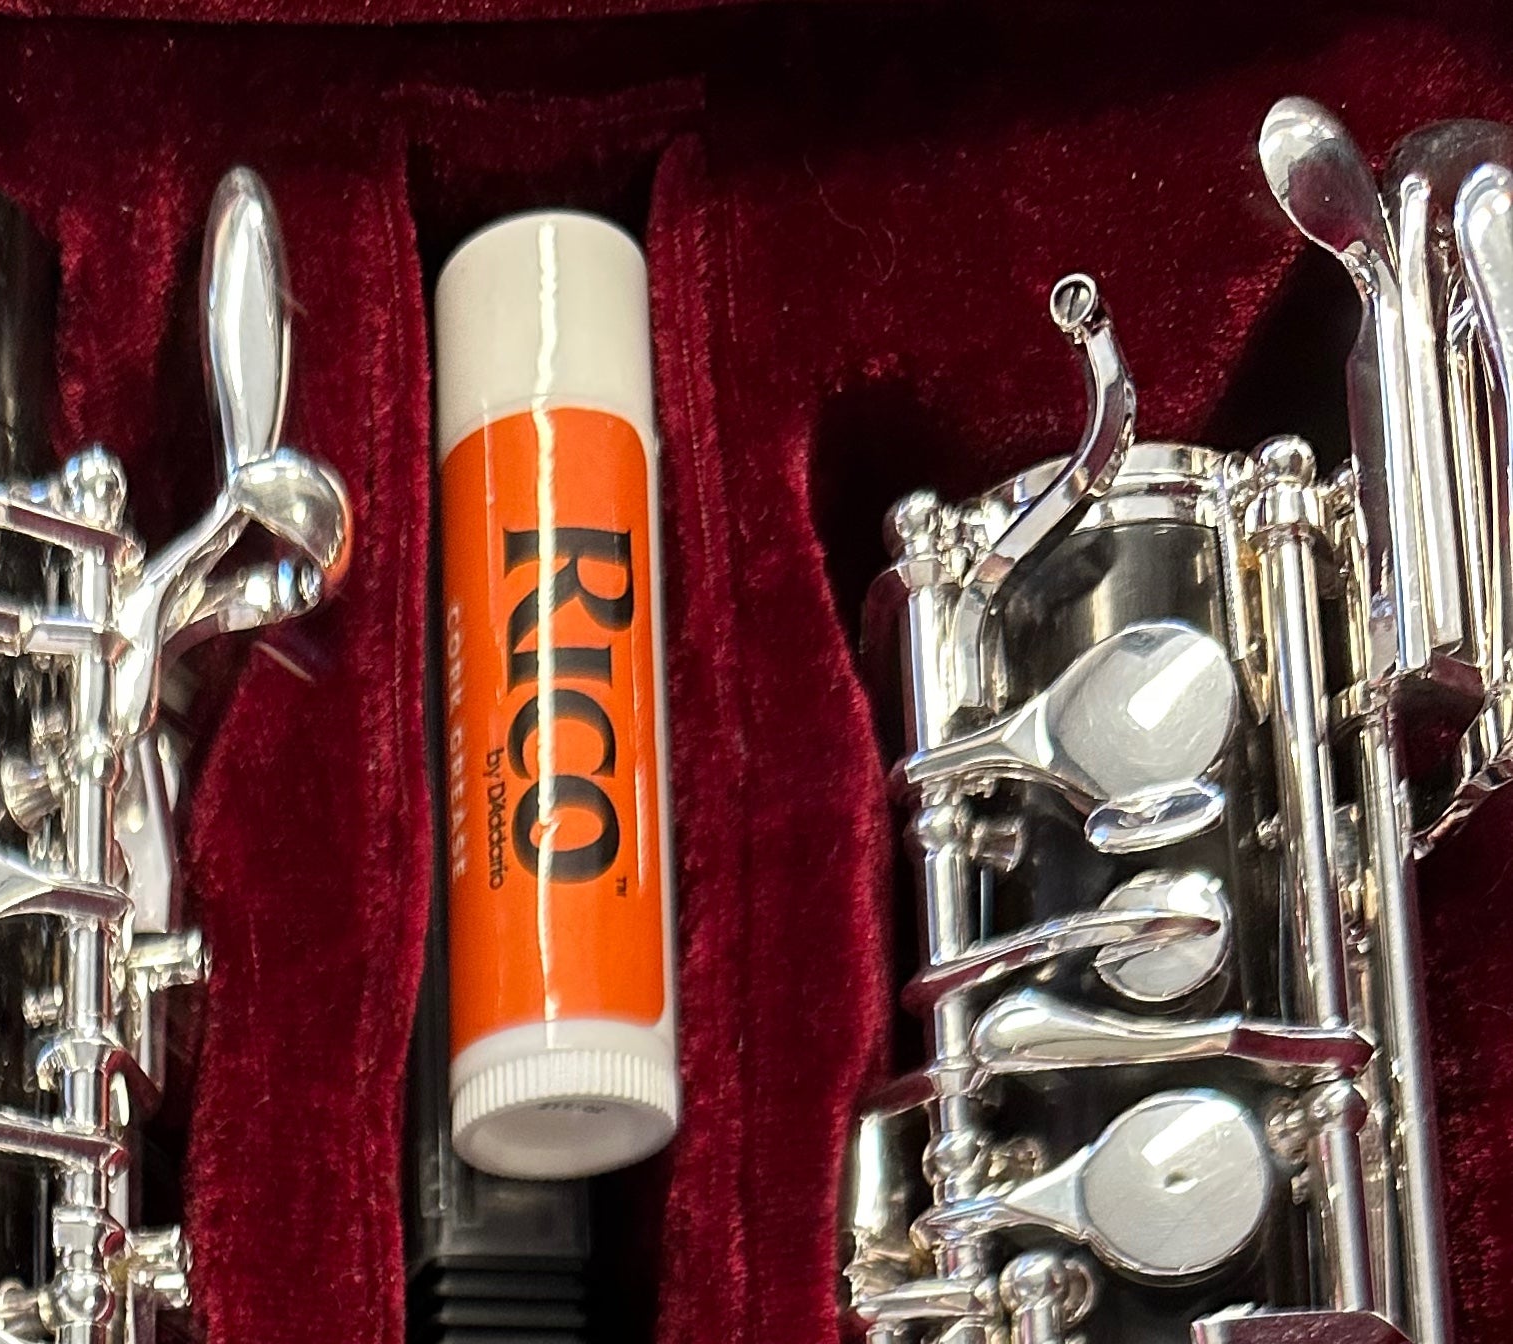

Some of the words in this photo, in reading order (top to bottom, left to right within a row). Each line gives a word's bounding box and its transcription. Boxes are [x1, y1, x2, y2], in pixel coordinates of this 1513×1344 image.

[446, 603, 470, 717] CORK
[449, 724, 471, 885] GREASE
[485, 747, 506, 779] by
